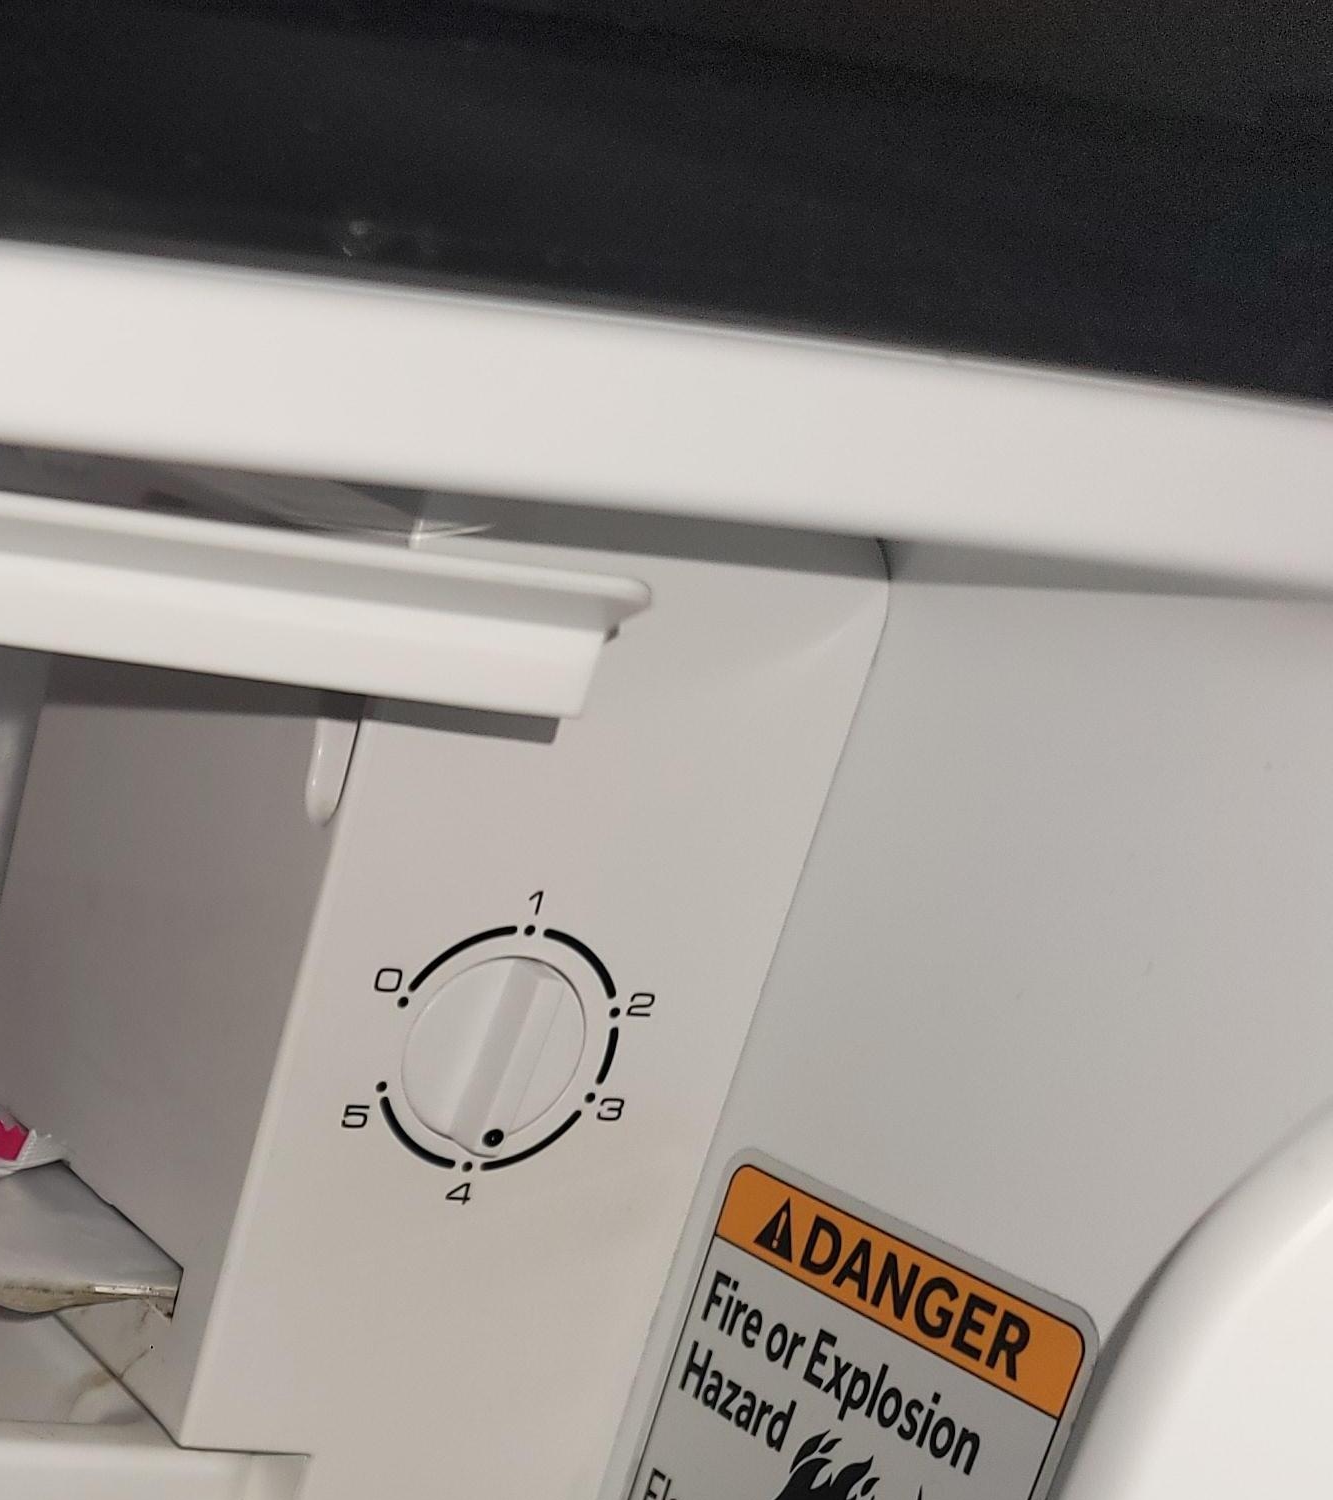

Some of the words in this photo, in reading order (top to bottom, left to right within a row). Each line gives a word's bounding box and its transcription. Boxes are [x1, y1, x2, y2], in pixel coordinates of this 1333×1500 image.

[528, 890, 545, 916] 1
[374, 968, 403, 993] 0
[626, 993, 656, 1017] 2
[341, 1104, 370, 1128] 5
[596, 1098, 625, 1121] 3
[445, 1182, 471, 1206] 4
[800, 1214, 1031, 1381] DANGER
[700, 1270, 763, 1349] Fire
[766, 1322, 806, 1370] or
[802, 1329, 981, 1476] Explosion
[678, 1341, 797, 1452] Hazard
